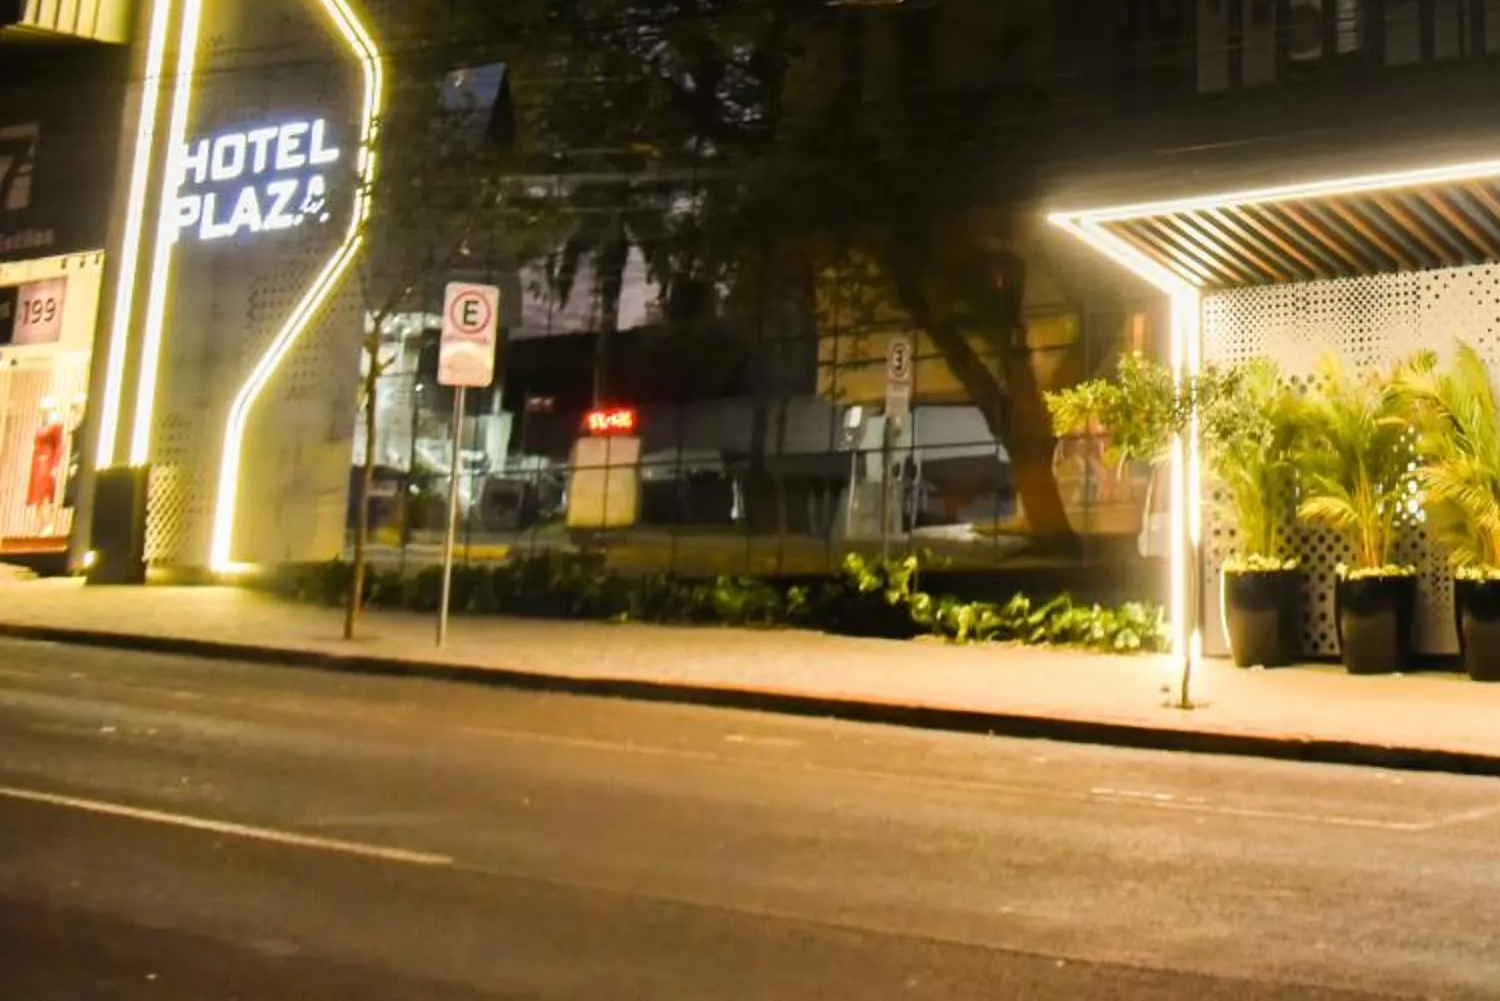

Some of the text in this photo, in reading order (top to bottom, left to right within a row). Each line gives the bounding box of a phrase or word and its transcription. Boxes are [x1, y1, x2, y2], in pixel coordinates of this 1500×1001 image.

[177, 118, 340, 185] HOTEL
[22, 298, 56, 326] 199
[463, 300, 479, 326] E
